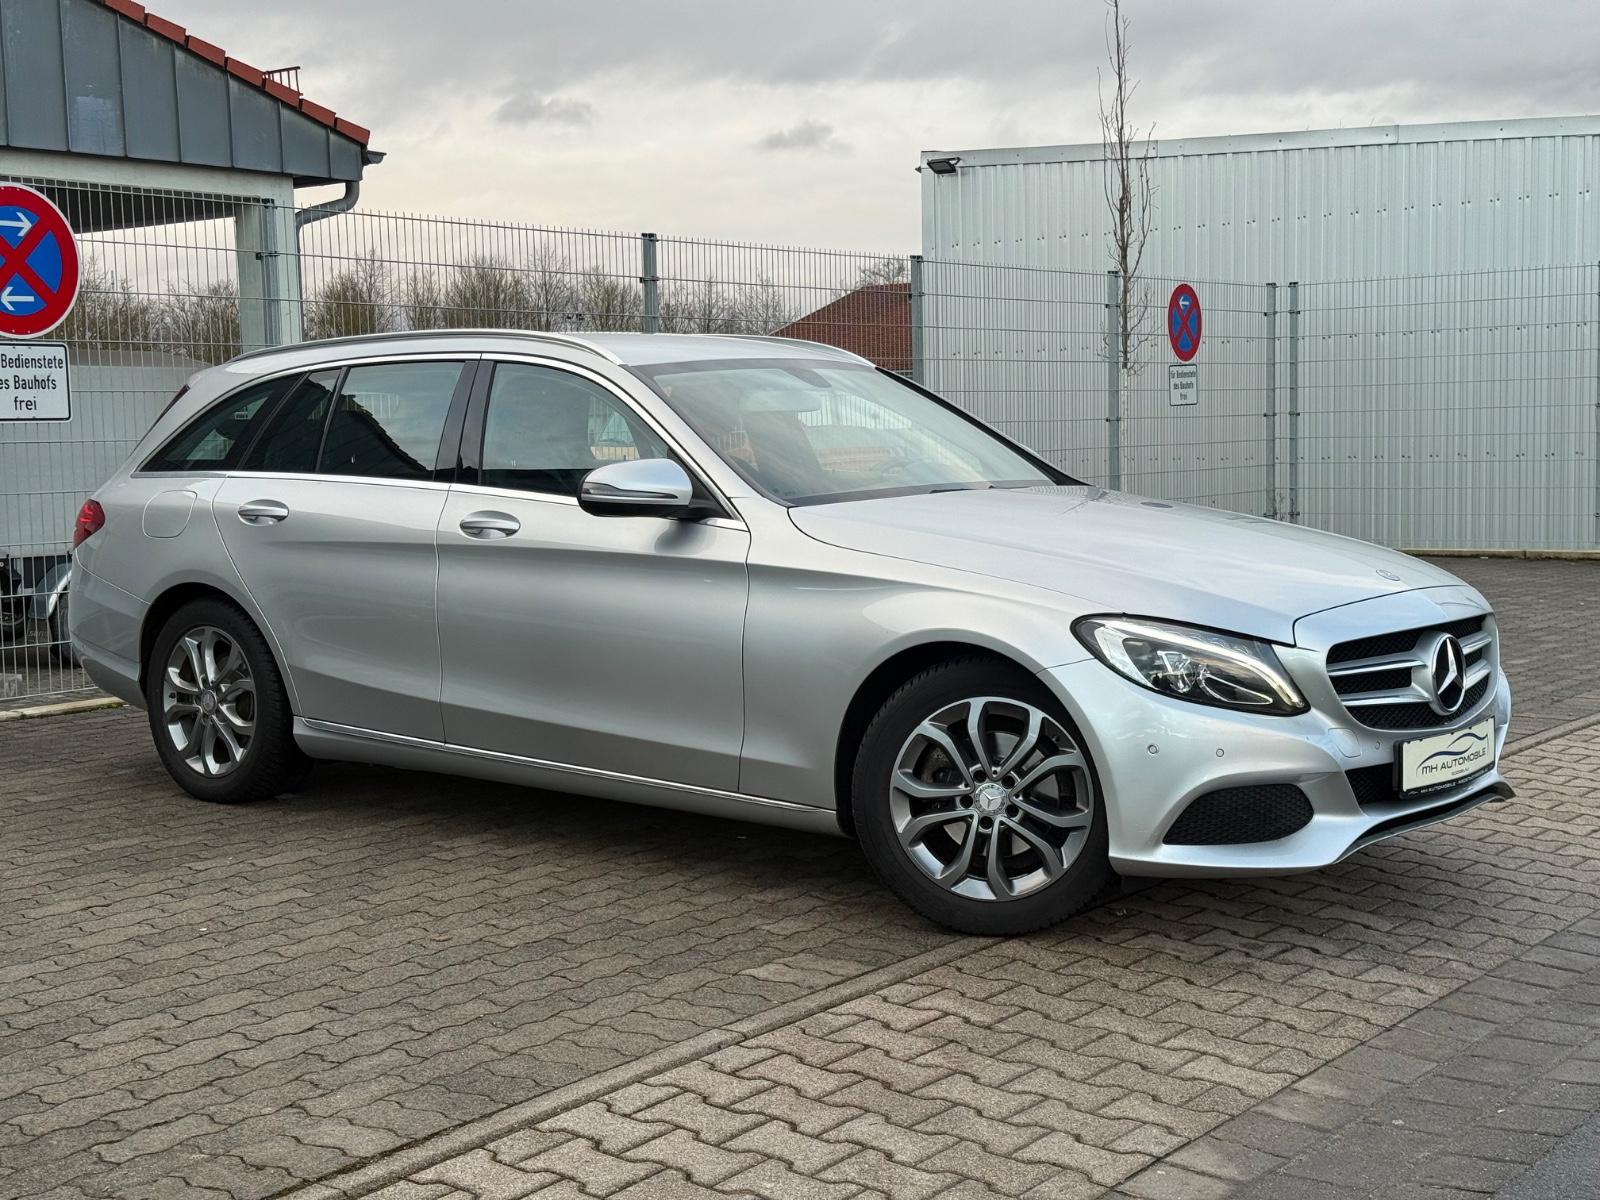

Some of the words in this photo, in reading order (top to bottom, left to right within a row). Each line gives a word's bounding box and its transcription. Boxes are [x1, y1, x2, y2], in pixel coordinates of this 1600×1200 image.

[0, 353, 64, 369] Bedienstete
[13, 374, 57, 390] Bauhofs
[14, 396, 37, 411] frei
[1421, 764, 1438, 775] MH
[1440, 748, 1486, 770] AUTOMOBILE
